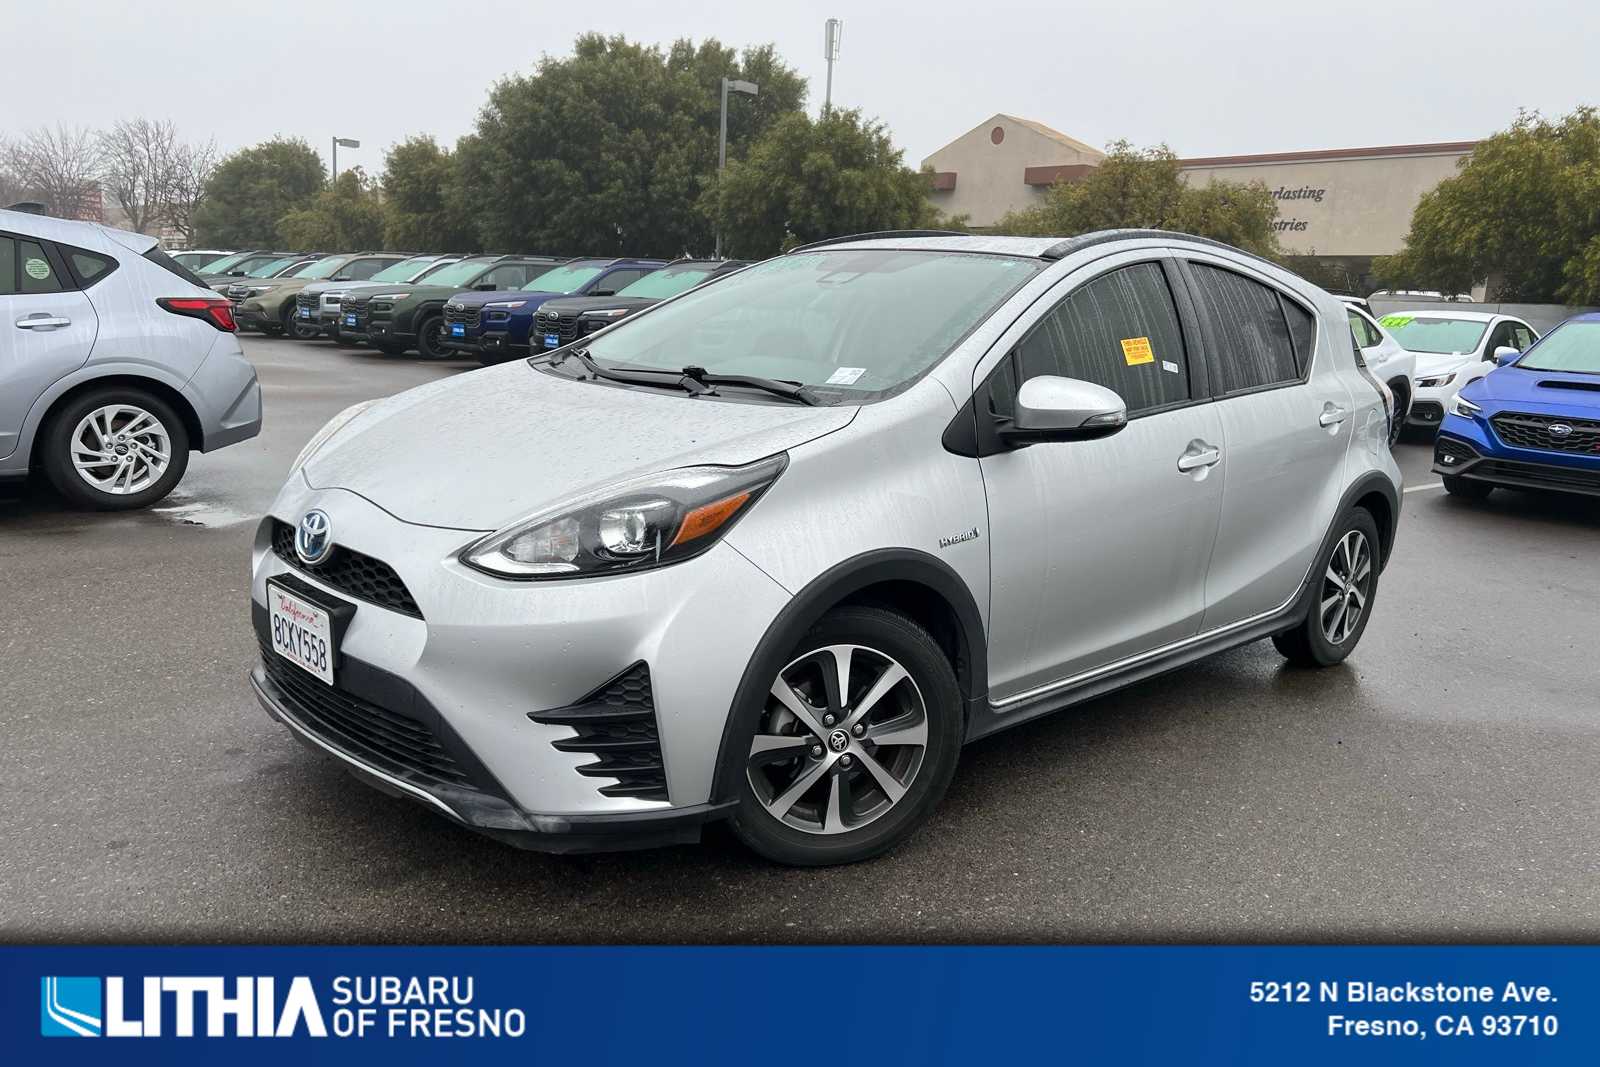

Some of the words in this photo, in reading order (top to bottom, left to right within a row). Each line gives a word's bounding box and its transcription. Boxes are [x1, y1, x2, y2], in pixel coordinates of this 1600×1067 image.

[1268, 186, 1326, 202] rlasting
[1267, 218, 1309, 232] istries
[939, 529, 976, 549] HYBRID
[273, 613, 327, 672] 8CKY558
